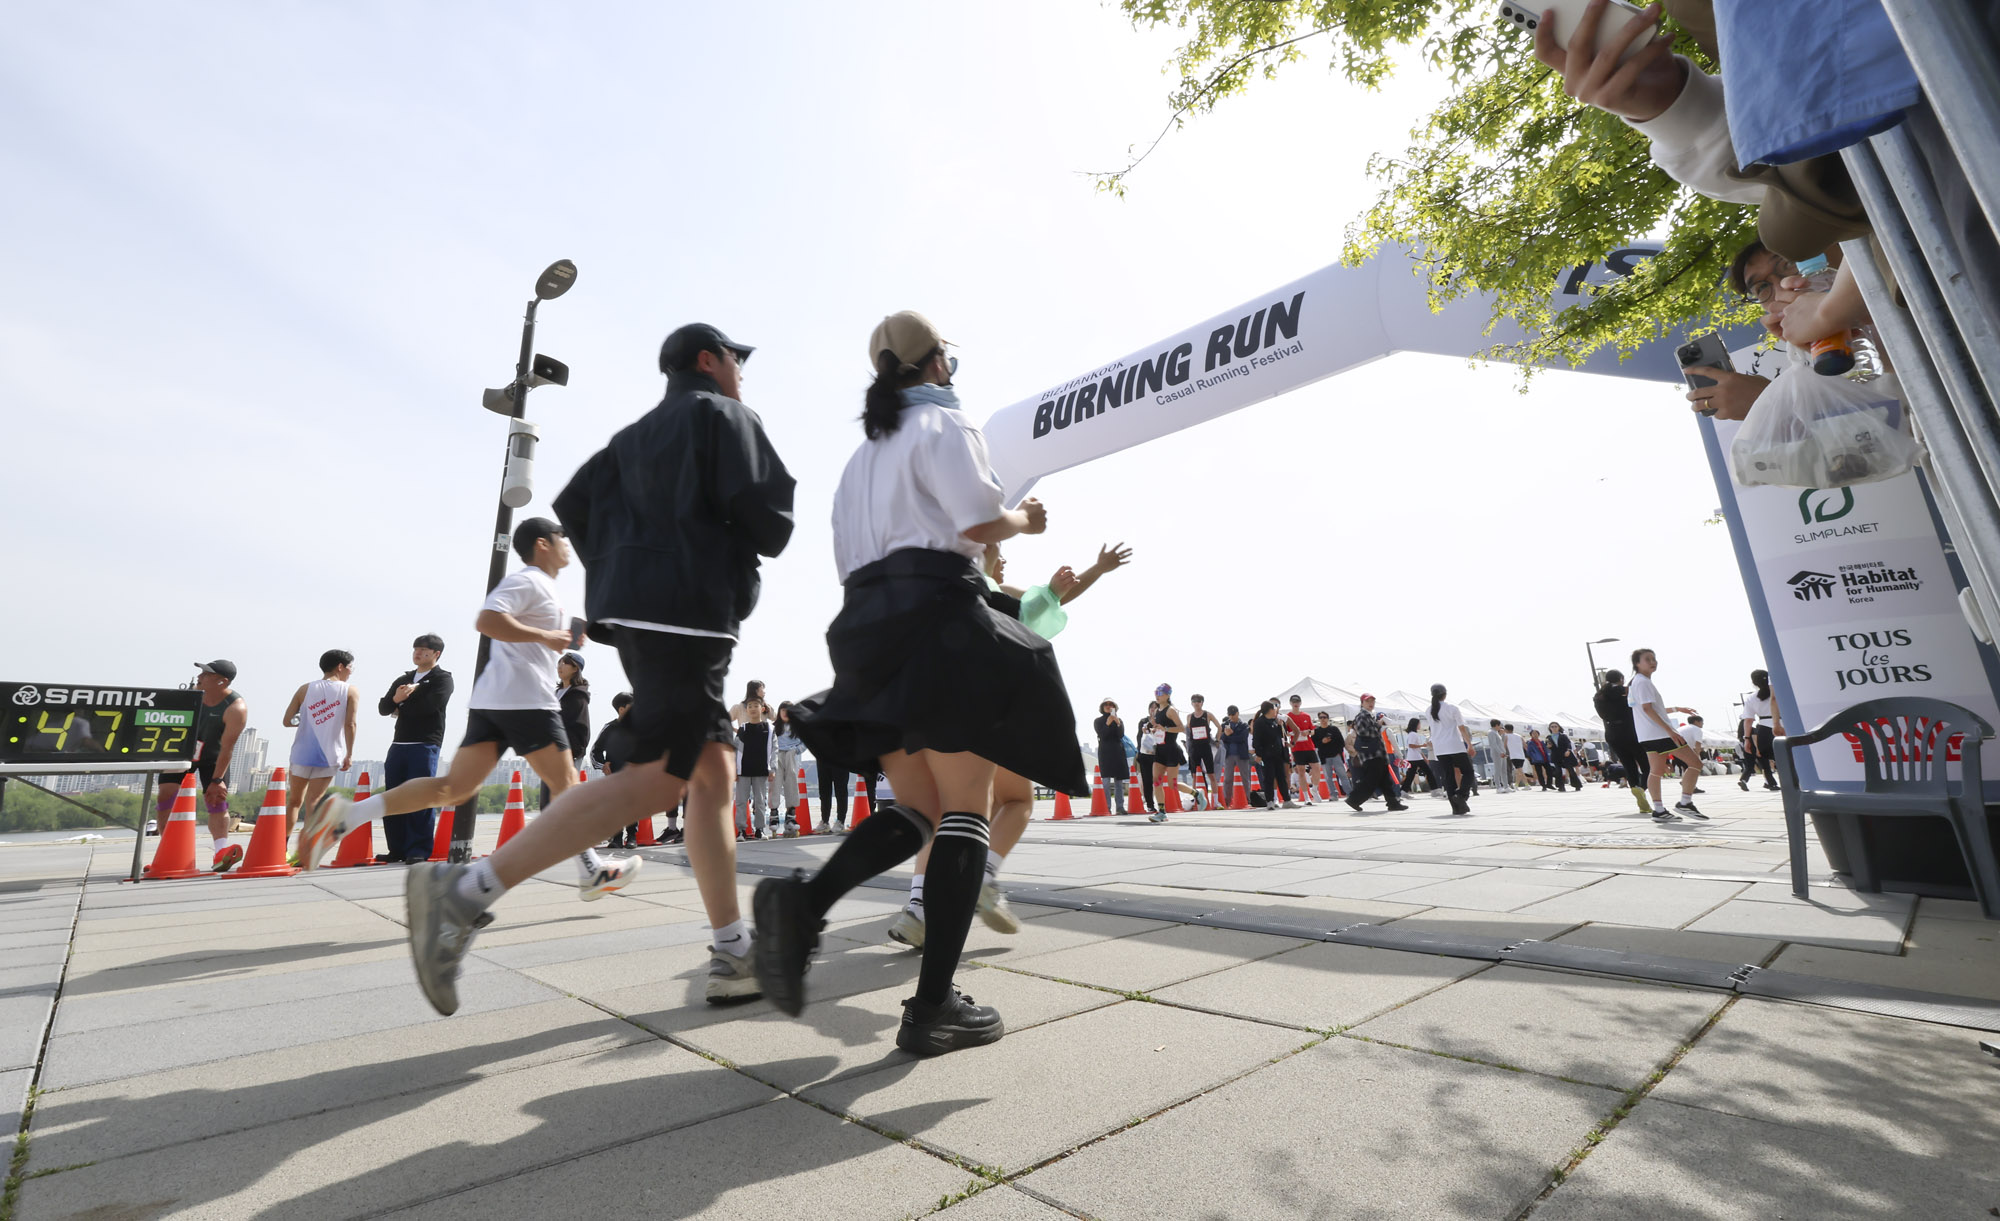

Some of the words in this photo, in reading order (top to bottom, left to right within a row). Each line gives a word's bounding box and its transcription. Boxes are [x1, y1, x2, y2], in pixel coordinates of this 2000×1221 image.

[1033, 342, 1193, 440] BURNING
[1204, 290, 1306, 373] RUN
[1156, 383, 1196, 406] Casual
[1196, 364, 1250, 391] Running
[1250, 340, 1304, 370] Festival
[1794, 522, 1880, 544] SLIMPLANET
[1841, 567, 1918, 587] Habitat
[1846, 587, 1863, 596] for
[1848, 596, 1875, 604] Korea
[1828, 629, 1912, 652] TOUS
[1862, 649, 1890, 667] les
[1835, 664, 1932, 691] JOURS
[44, 688, 157, 707] SAMIK
[308, 699, 327, 711] WOW
[143, 711, 185, 725] 10km
[312, 700, 341, 719] RUNNING
[315, 712, 335, 726] CLASS
